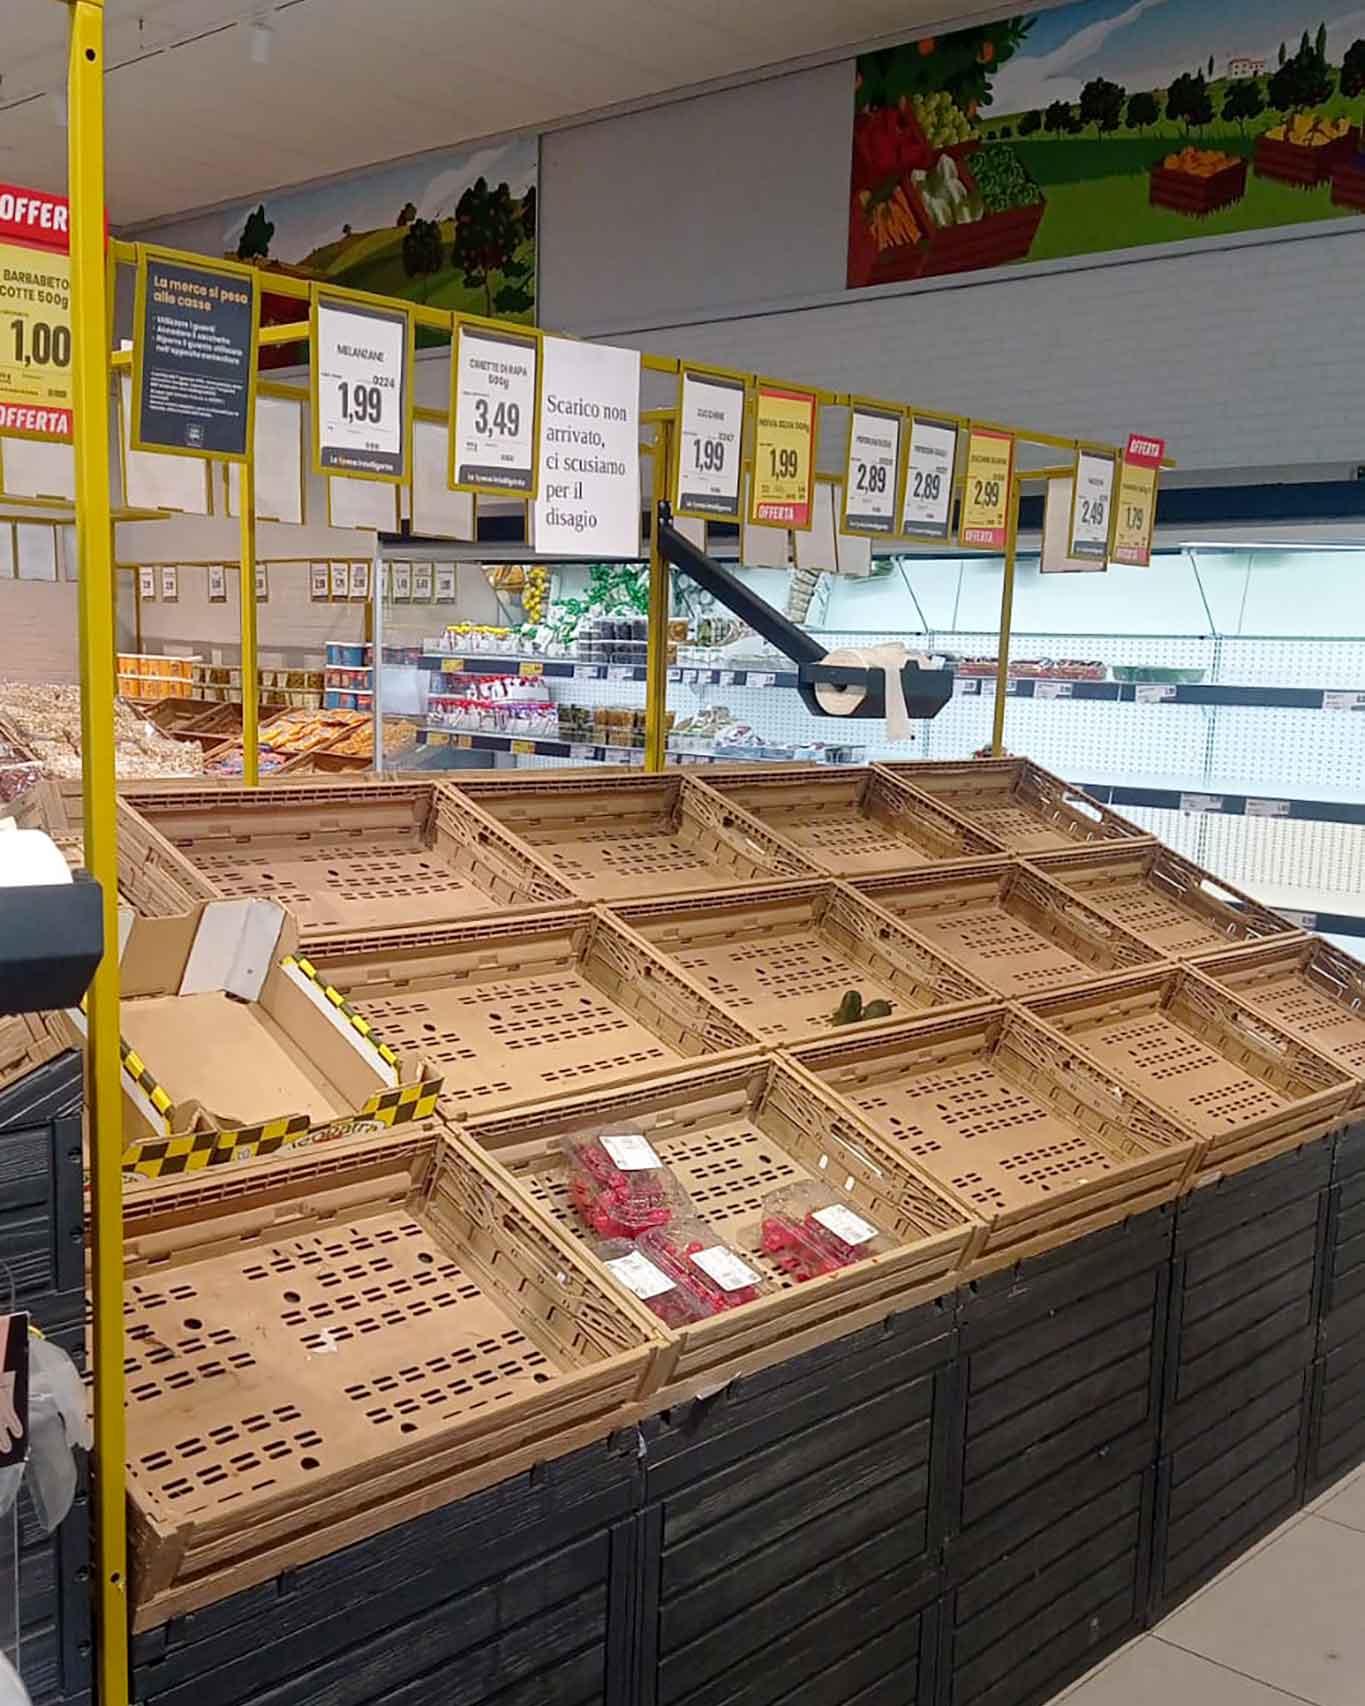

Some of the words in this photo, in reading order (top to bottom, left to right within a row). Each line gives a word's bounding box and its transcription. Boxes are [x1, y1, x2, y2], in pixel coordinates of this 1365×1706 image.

[0, 193, 67, 232] OFFER
[154, 275, 168, 288] La
[10, 319, 71, 367] 1,00
[508, 365, 527, 377] RAPA
[338, 381, 382, 423] 1,99
[547, 394, 599, 418] Scarico
[603, 406, 627, 421] non
[475, 398, 520, 438] 3,49
[546, 425, 605, 448] arrivato,
[546, 452, 558, 470] ci
[563, 455, 626, 475] scusiamo
[693, 439, 725, 472] 1,99
[770, 448, 798, 480] 1,99
[546, 483, 570, 502] per
[574, 481, 583, 499] il
[856, 463, 887, 495] 2,89
[913, 471, 941, 501] 2,89
[974, 480, 1000, 509] 2,99
[546, 507, 598, 533] disagio
[758, 503, 794, 520] OFFERTA
[1081, 500, 1104, 526] 2,49
